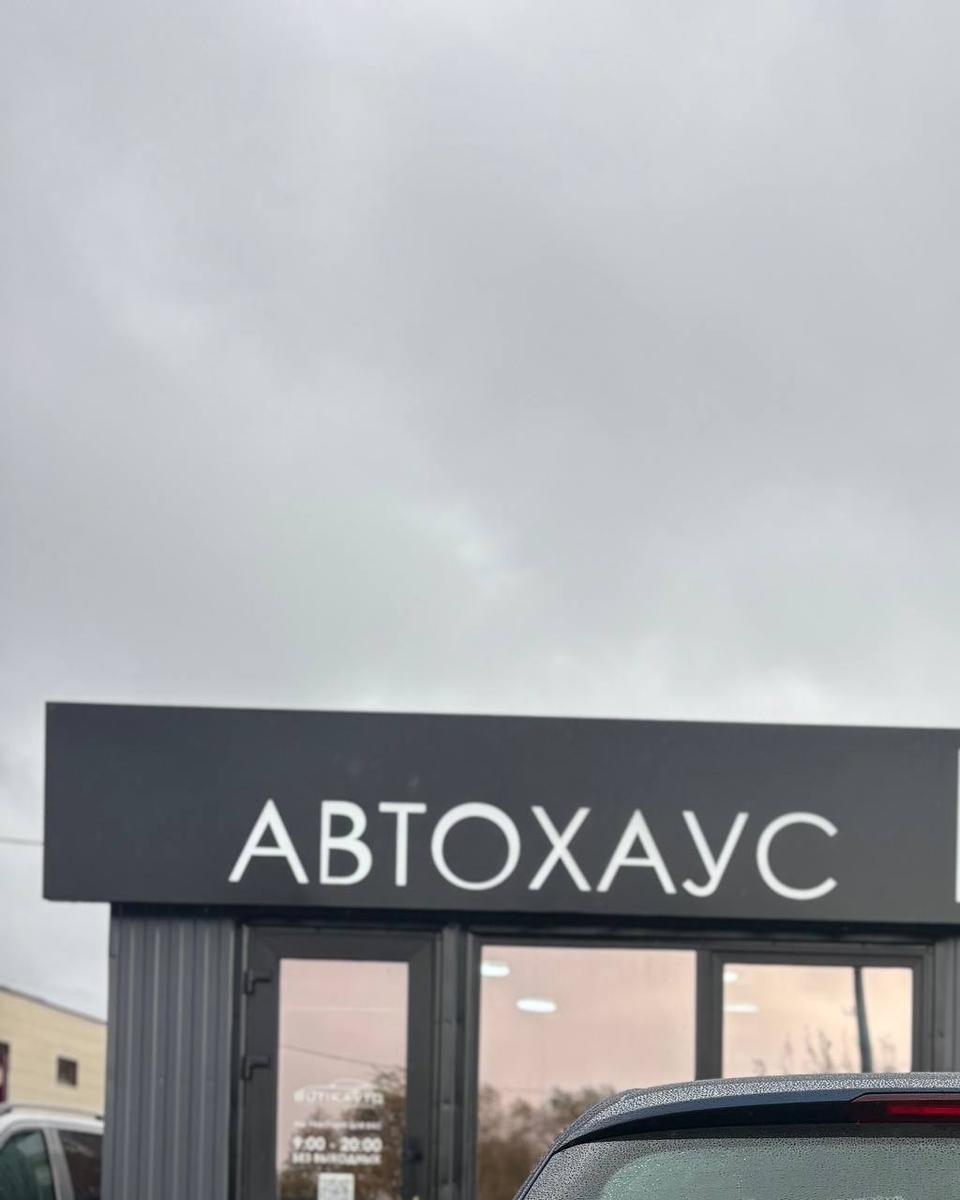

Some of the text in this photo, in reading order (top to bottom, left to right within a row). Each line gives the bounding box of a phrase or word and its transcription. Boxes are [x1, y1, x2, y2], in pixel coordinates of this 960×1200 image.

[228, 798, 839, 901] АВТОХАУС
[292, 1135, 326, 1152] 9:00
[339, 1136, 383, 1153] 20:00
